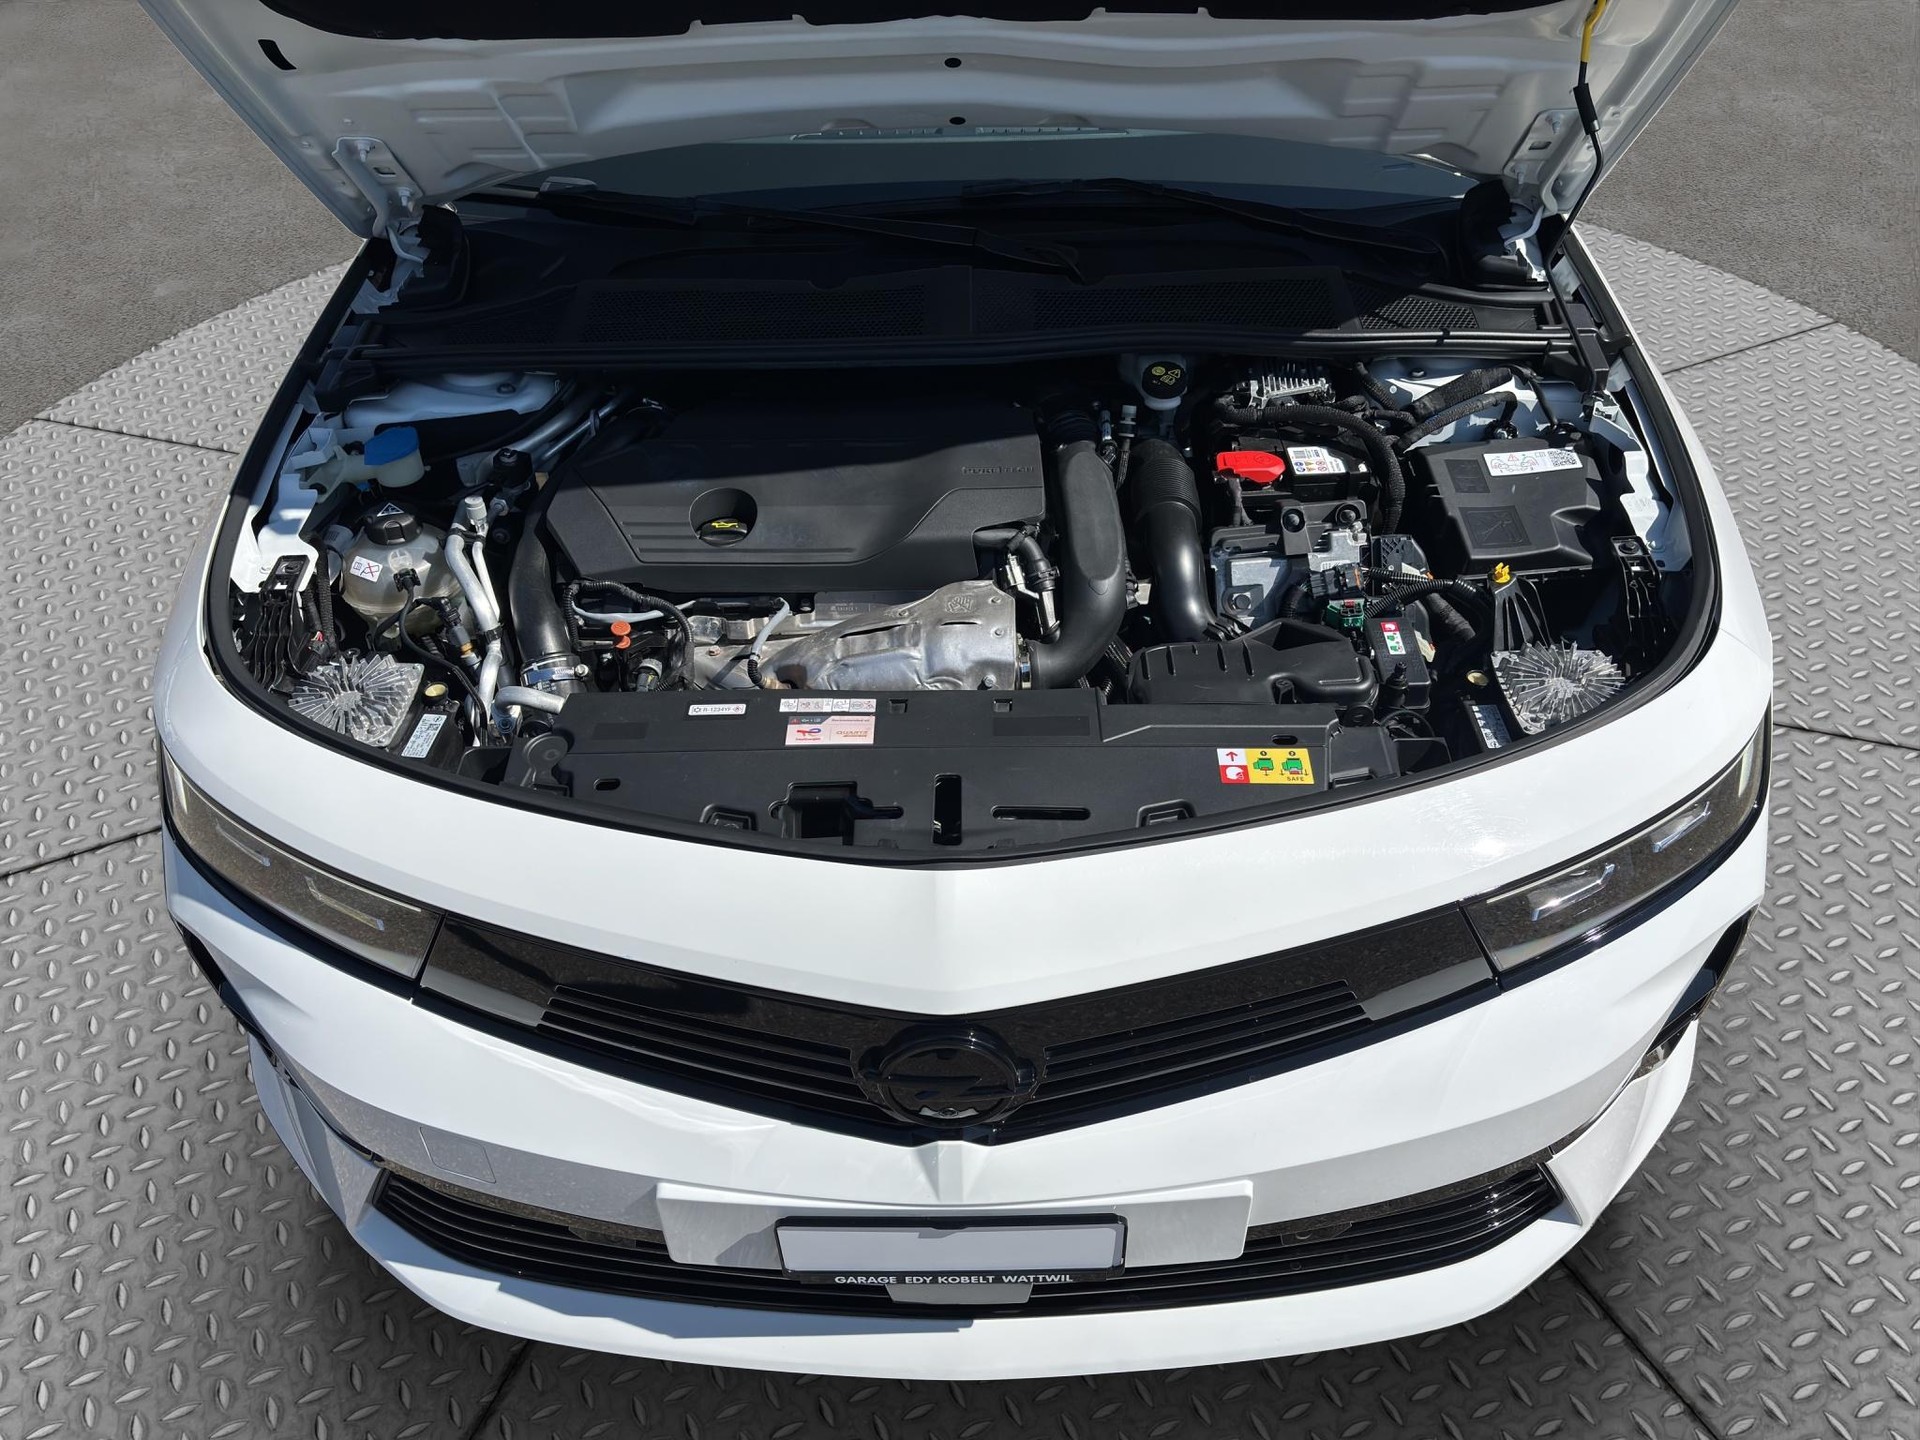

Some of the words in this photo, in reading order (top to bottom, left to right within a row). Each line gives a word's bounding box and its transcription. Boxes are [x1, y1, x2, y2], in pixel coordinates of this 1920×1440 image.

[834, 1276, 897, 1284] GARAGE
[905, 1276, 933, 1284] EDY
[938, 1275, 995, 1284] KOBELT
[1002, 1274, 1073, 1283] WATTWIL
